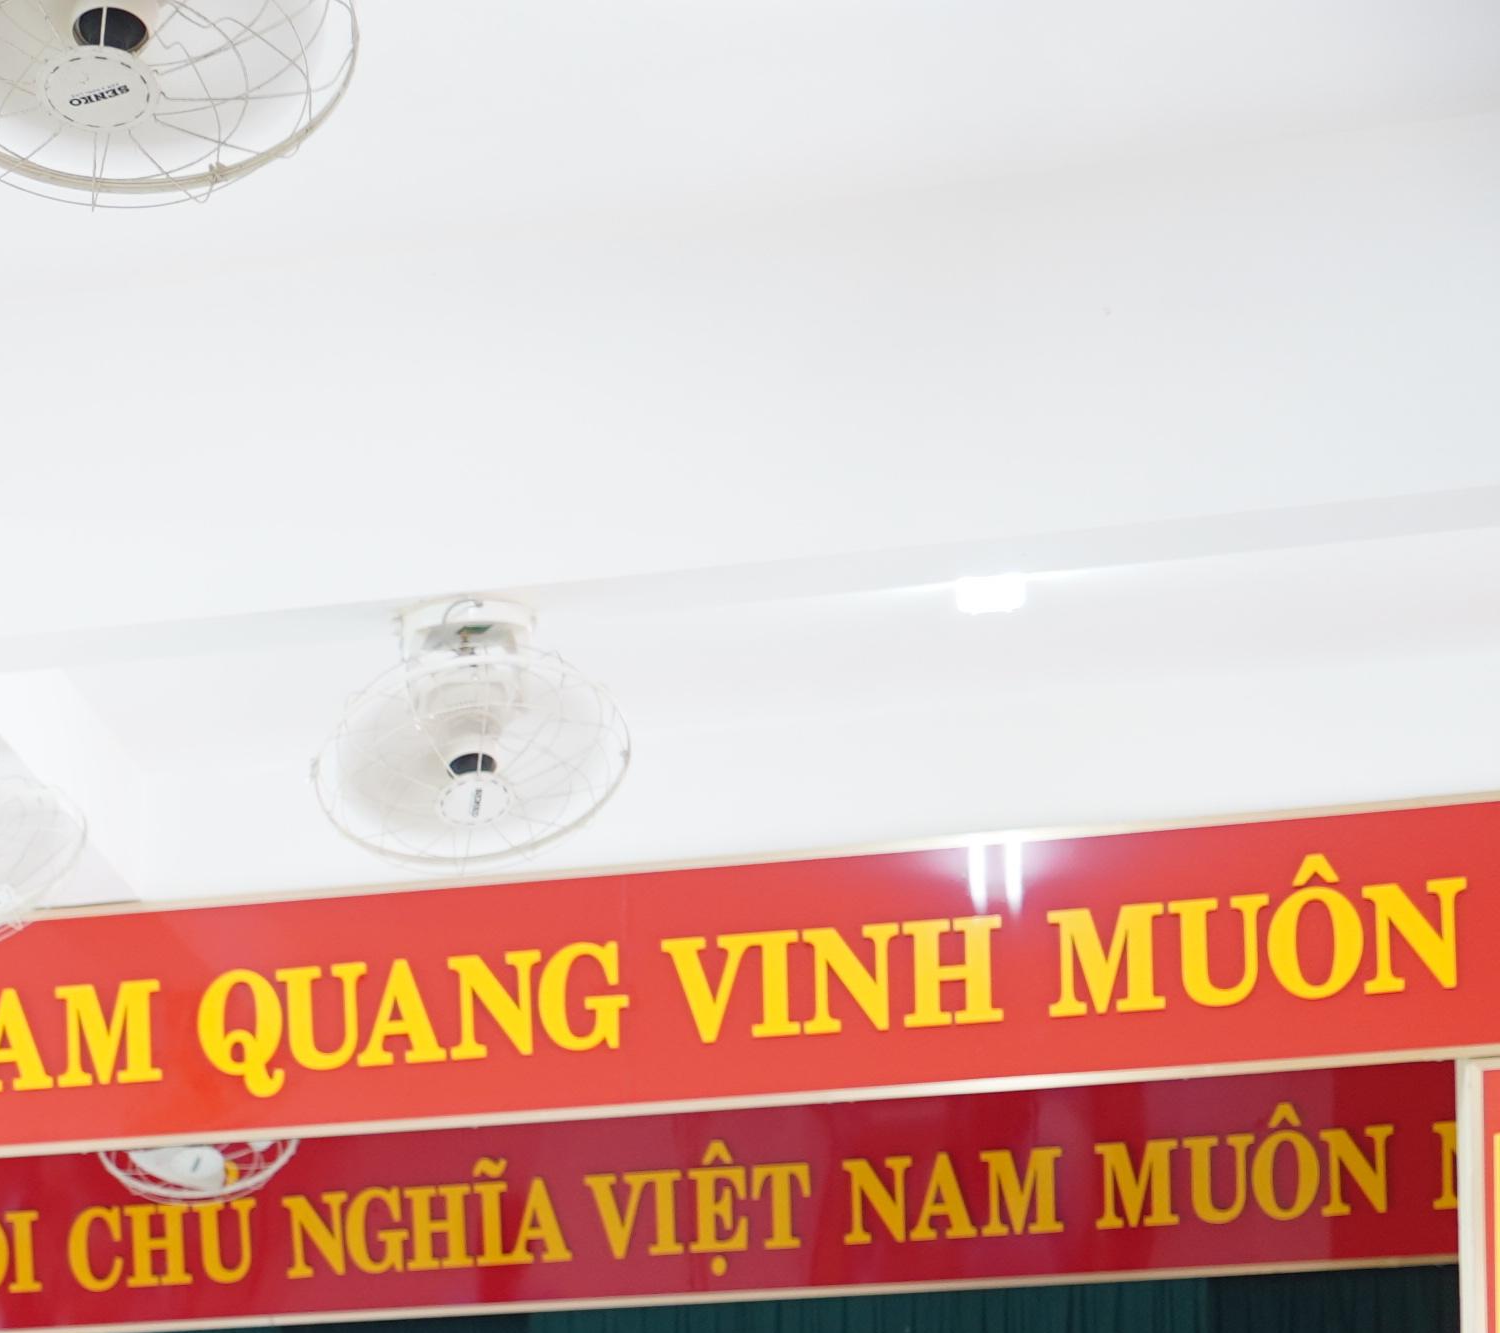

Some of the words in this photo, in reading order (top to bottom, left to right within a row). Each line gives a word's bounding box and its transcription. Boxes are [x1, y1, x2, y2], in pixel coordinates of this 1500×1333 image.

[69, 85, 130, 107] SENKO
[197, 941, 629, 1097] QUANG
[661, 914, 1004, 1044] VINH
[1047, 854, 1468, 1018] MUÔN
[284, 1158, 572, 1278] NGHĨA
[585, 1140, 811, 1276] VIỆT
[844, 1147, 1064, 1245] NAM
[1095, 1103, 1394, 1229] MUÔN
